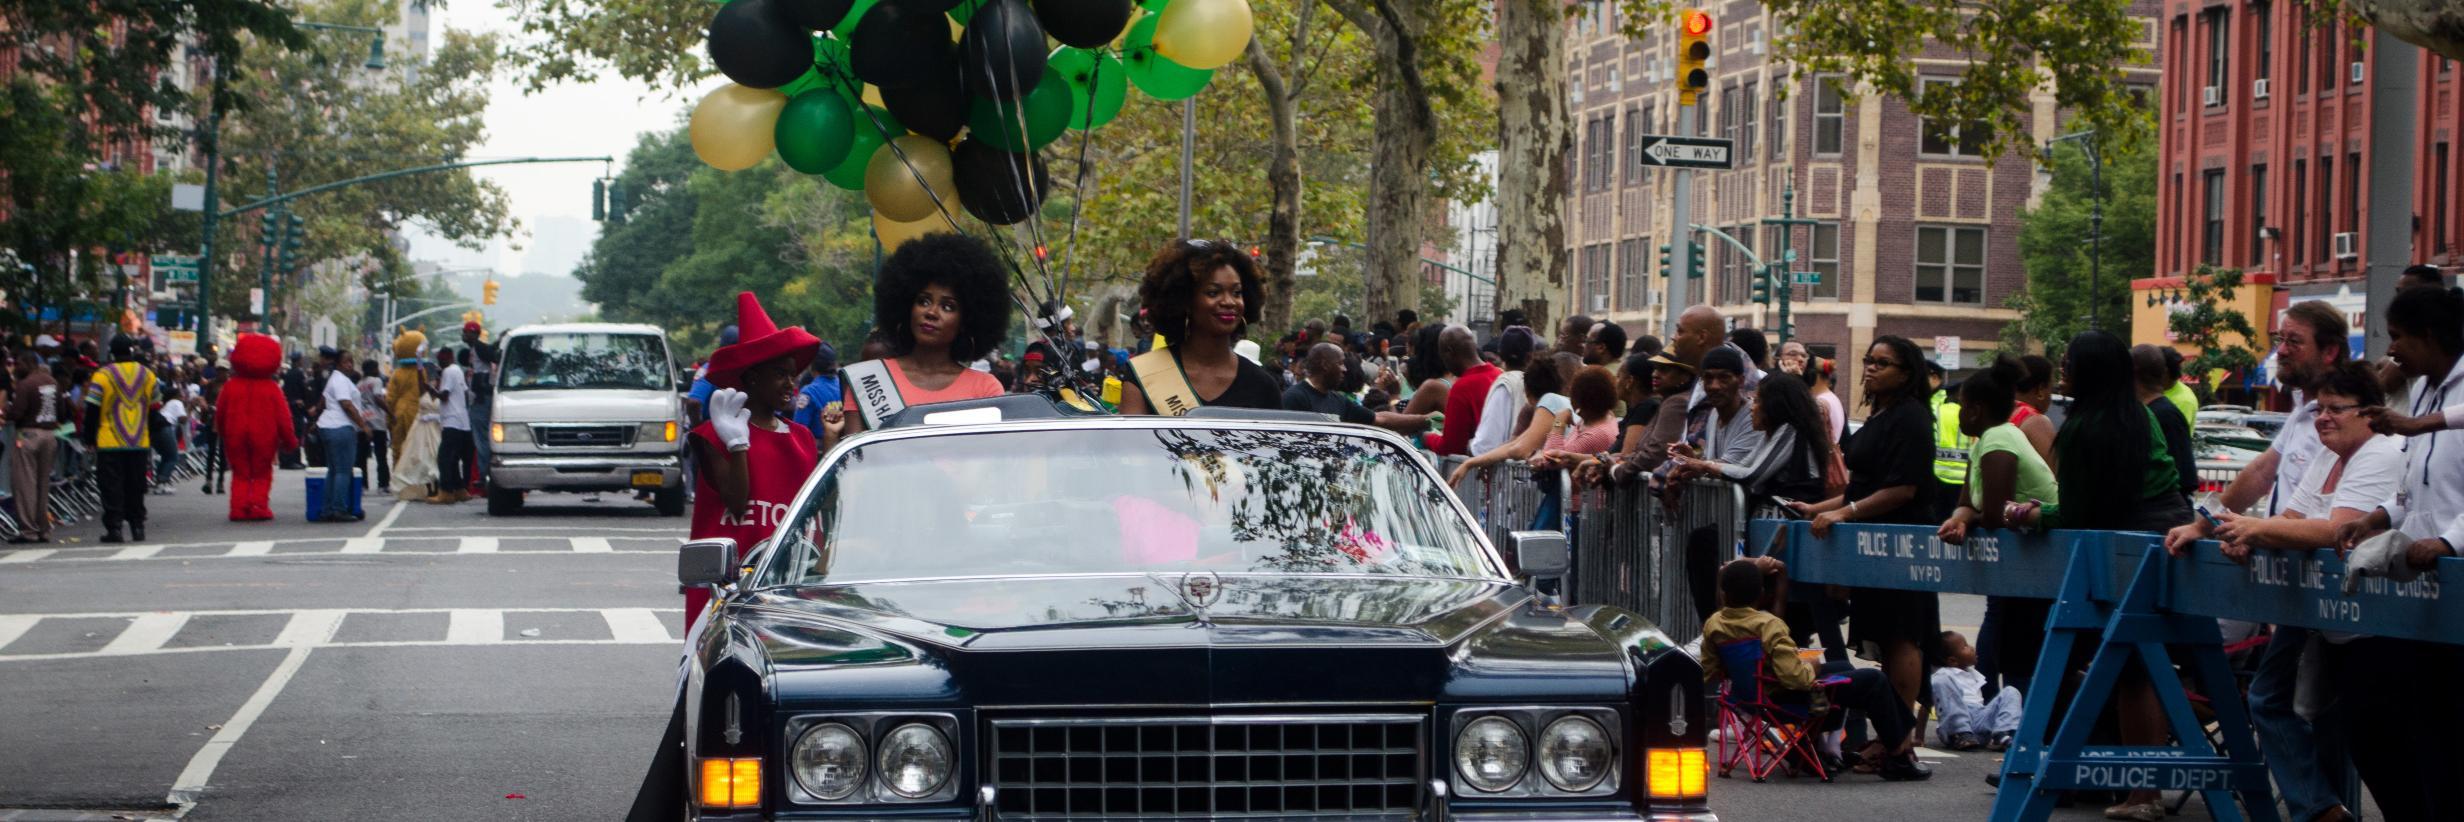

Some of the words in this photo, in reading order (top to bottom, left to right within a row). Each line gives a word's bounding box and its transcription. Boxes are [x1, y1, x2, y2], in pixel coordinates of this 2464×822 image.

[1655, 145, 1680, 158] ONE
[1693, 147, 1721, 160] WAY
[861, 373, 887, 407] MISS
[1857, 531, 1888, 557] POLICE
[1894, 533, 1914, 559] LINE
[1928, 535, 1941, 560] DO
[1966, 536, 1999, 563] CROSS
[1910, 565, 1942, 583] NYPD
[2250, 555, 2289, 586] POLICE
[2300, 559, 2325, 590] LINE
[2319, 598, 2360, 622] NYPD
[2075, 764, 2158, 788] POLICE
